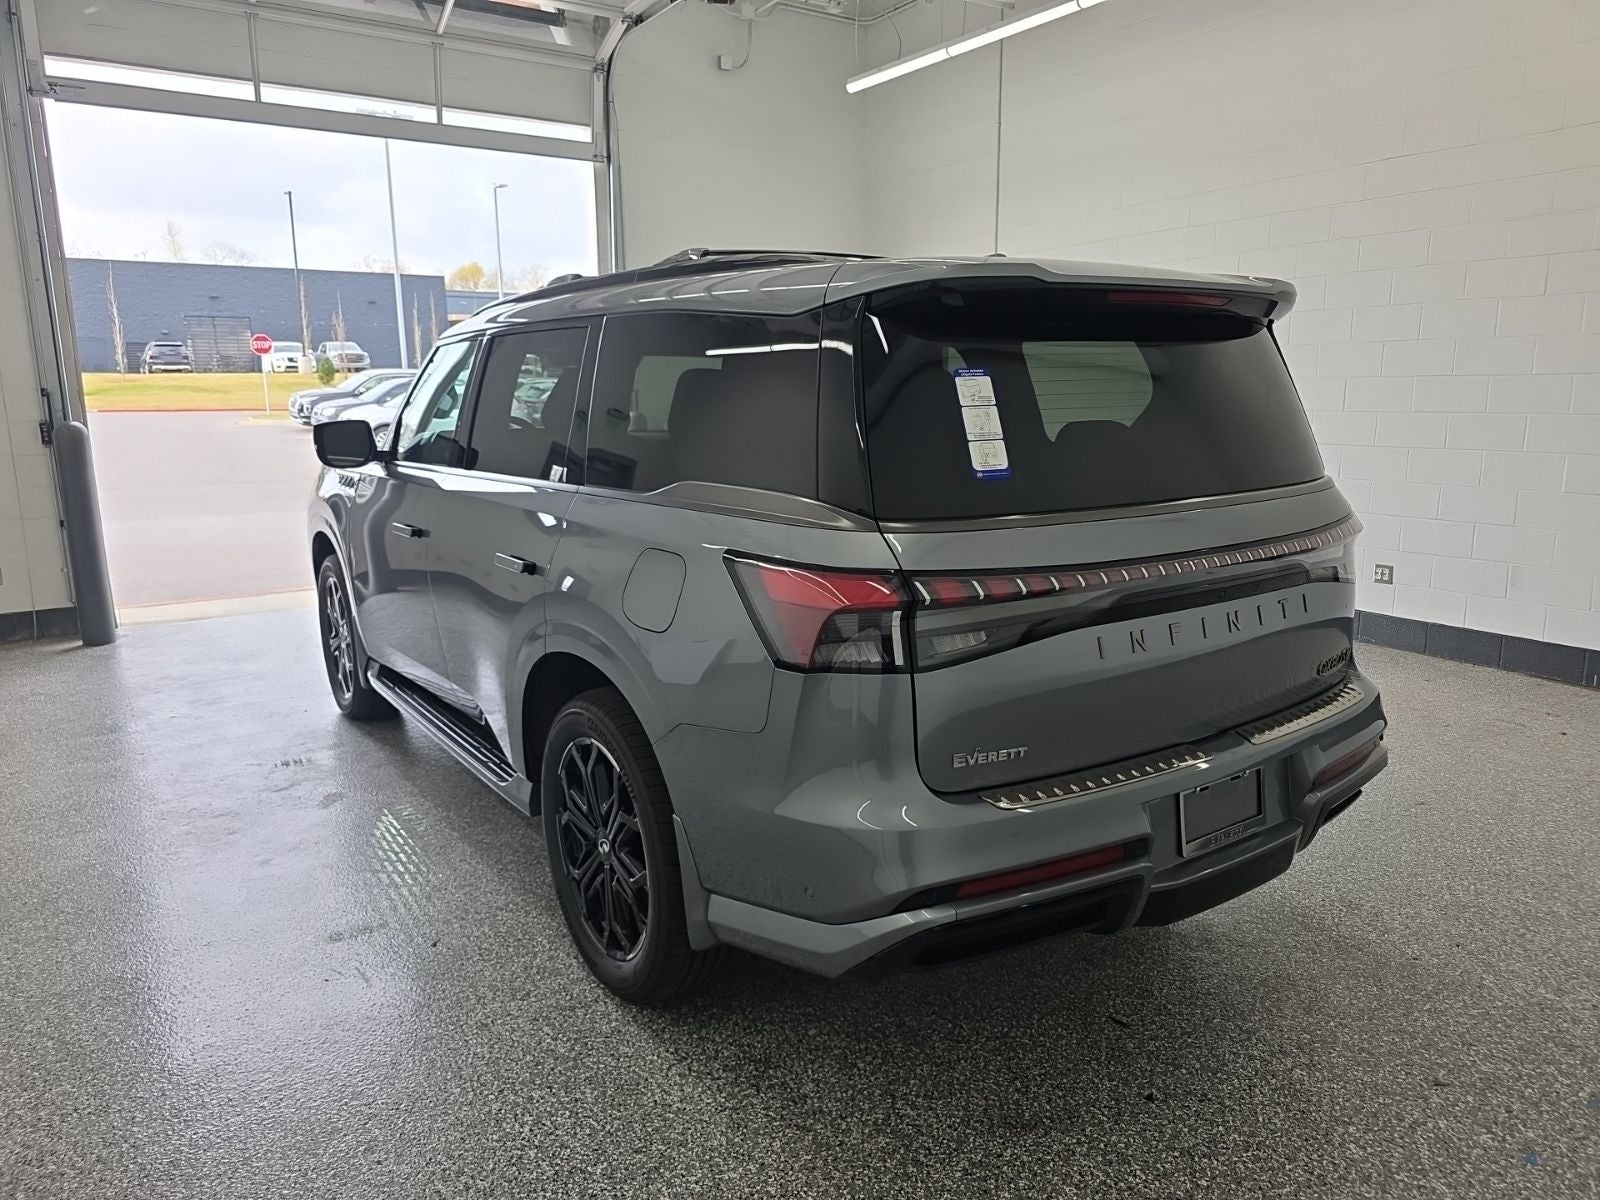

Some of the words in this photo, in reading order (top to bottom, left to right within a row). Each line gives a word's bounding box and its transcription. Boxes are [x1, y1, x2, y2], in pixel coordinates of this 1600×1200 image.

[252, 341, 271, 349] STOP
[1096, 593, 1308, 660] INFINITI
[952, 746, 1029, 768] EVERETT
